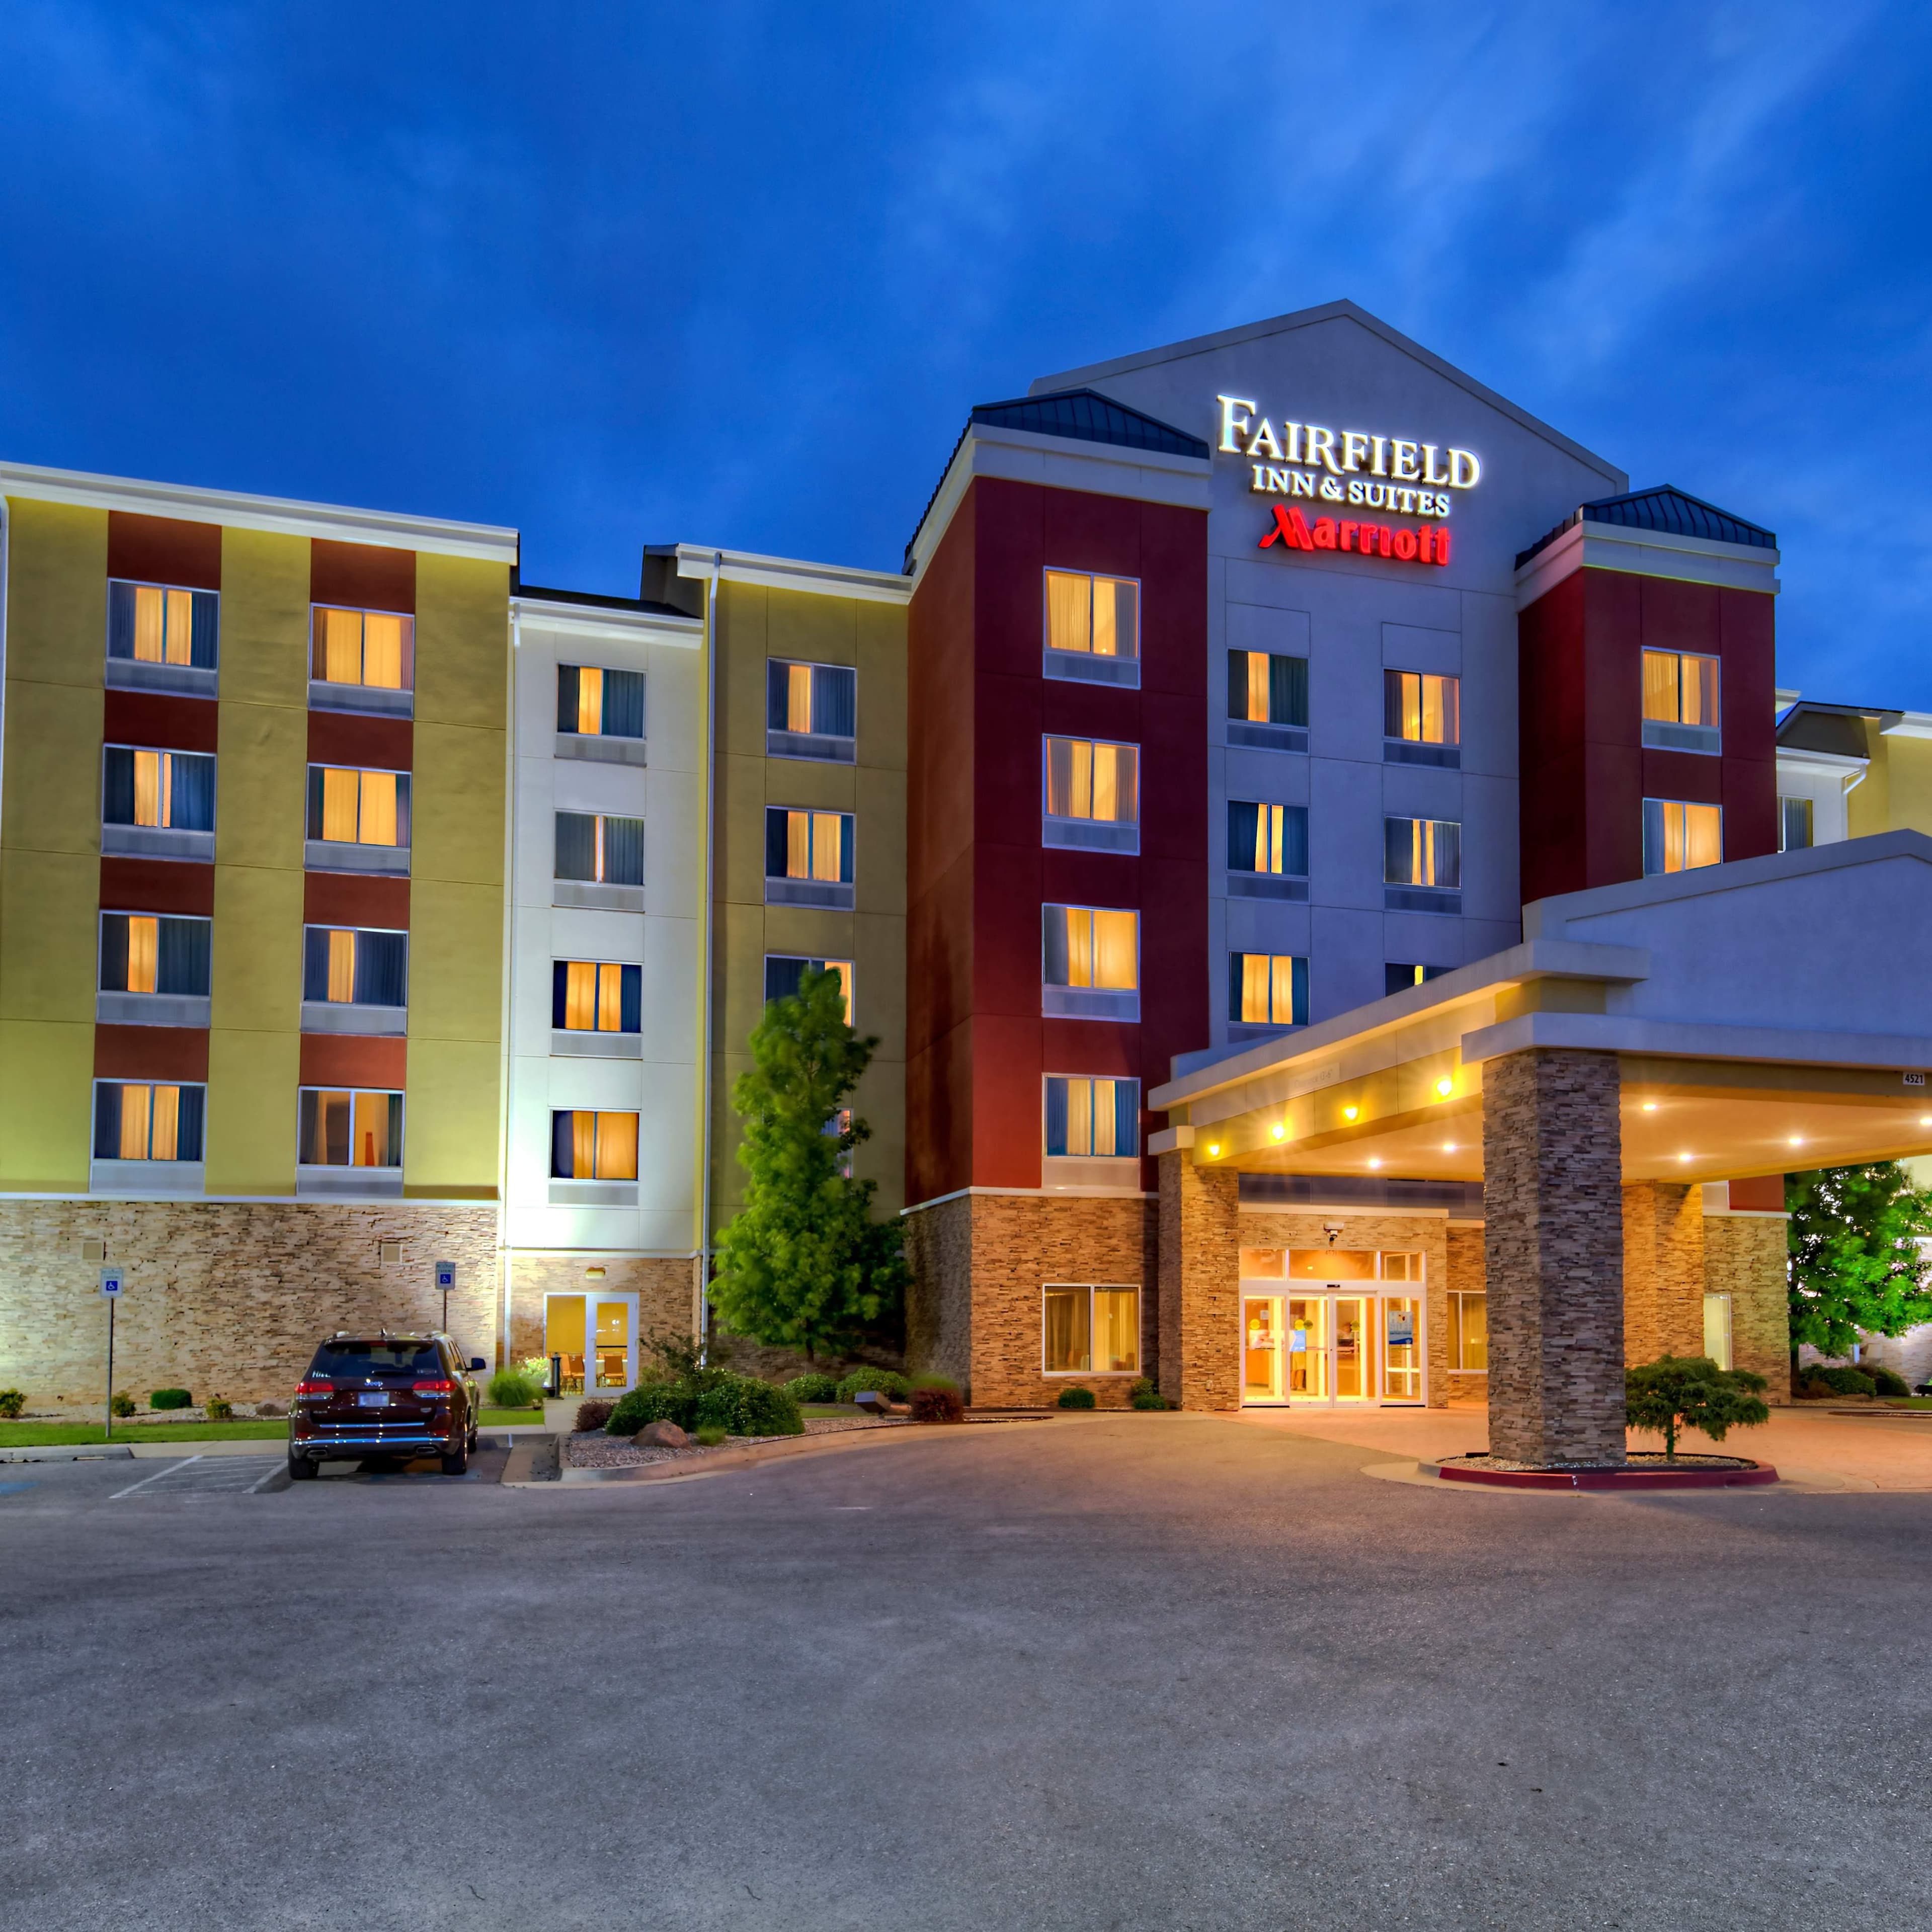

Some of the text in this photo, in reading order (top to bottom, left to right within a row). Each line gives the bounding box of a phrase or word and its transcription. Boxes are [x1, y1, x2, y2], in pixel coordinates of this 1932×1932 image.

[1217, 394, 1482, 489] FAIRFIELD
[1252, 464, 1451, 518] INN & SUITES
[1258, 504, 1451, 567] Marriott
[1905, 1074, 1923, 1084] 4521
